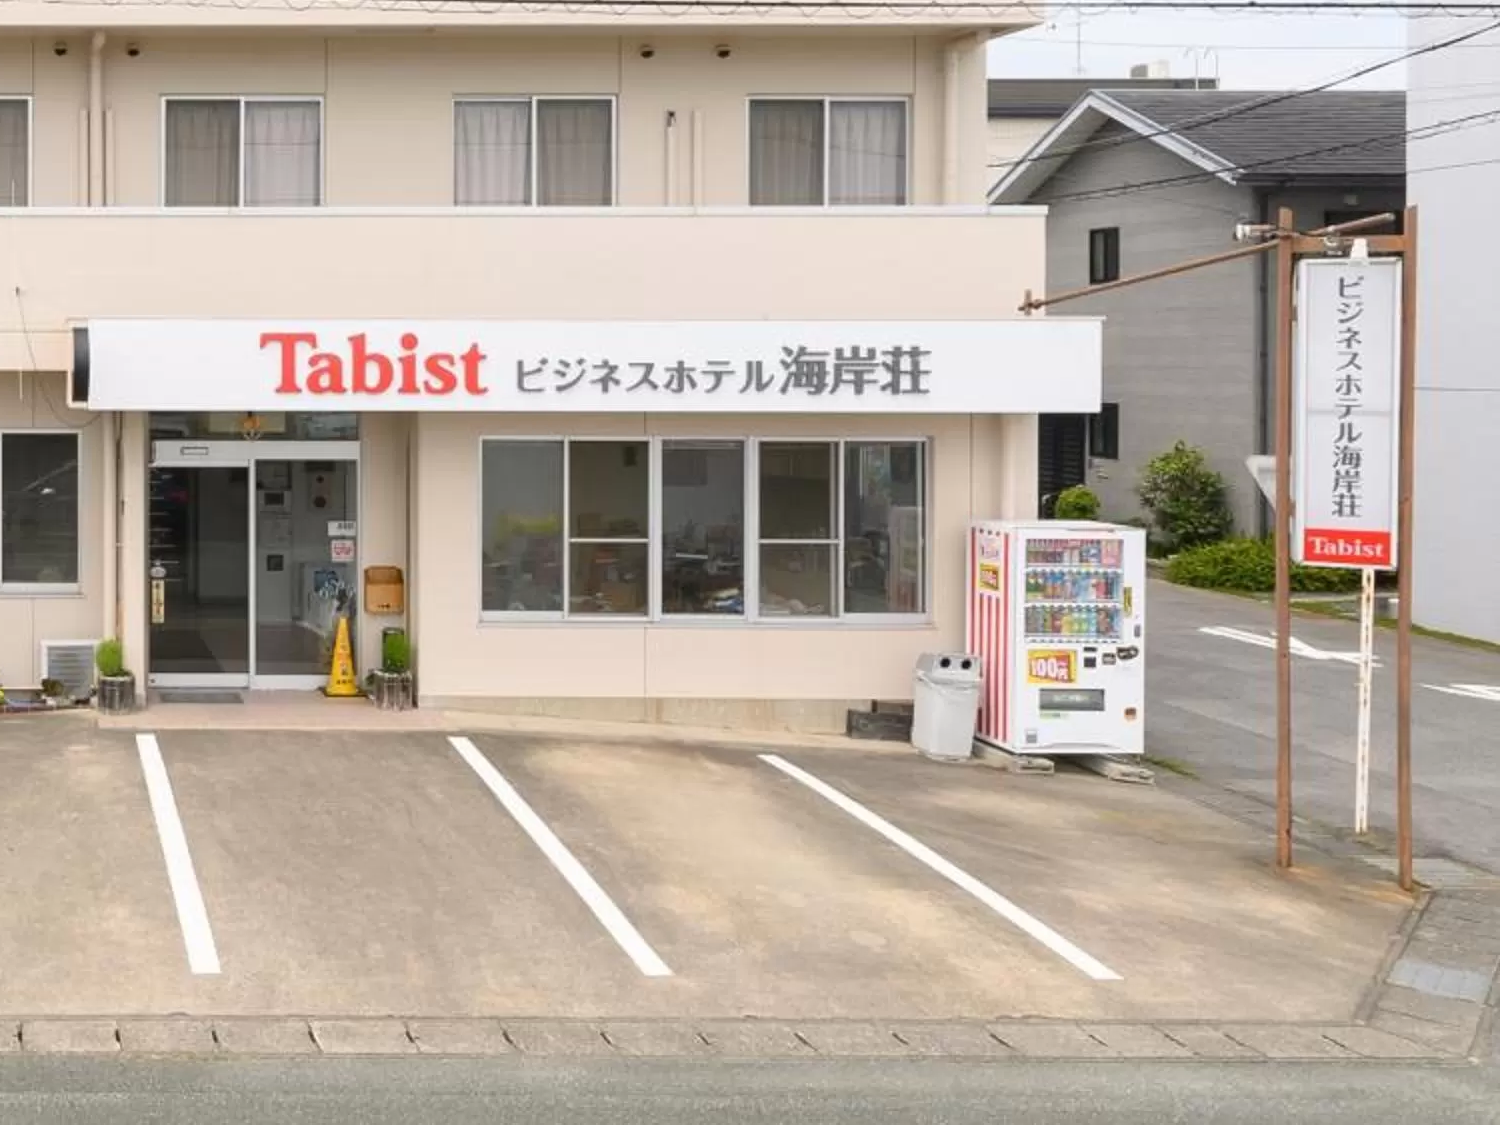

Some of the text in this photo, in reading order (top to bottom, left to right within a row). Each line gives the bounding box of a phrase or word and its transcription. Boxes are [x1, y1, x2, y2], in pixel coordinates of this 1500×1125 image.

[260, 331, 932, 396] Tabist ビジネスホテル海岸荘
[1331, 276, 1364, 518] ビジネスホテル海岸荘
[1308, 537, 1385, 557] Tabist
